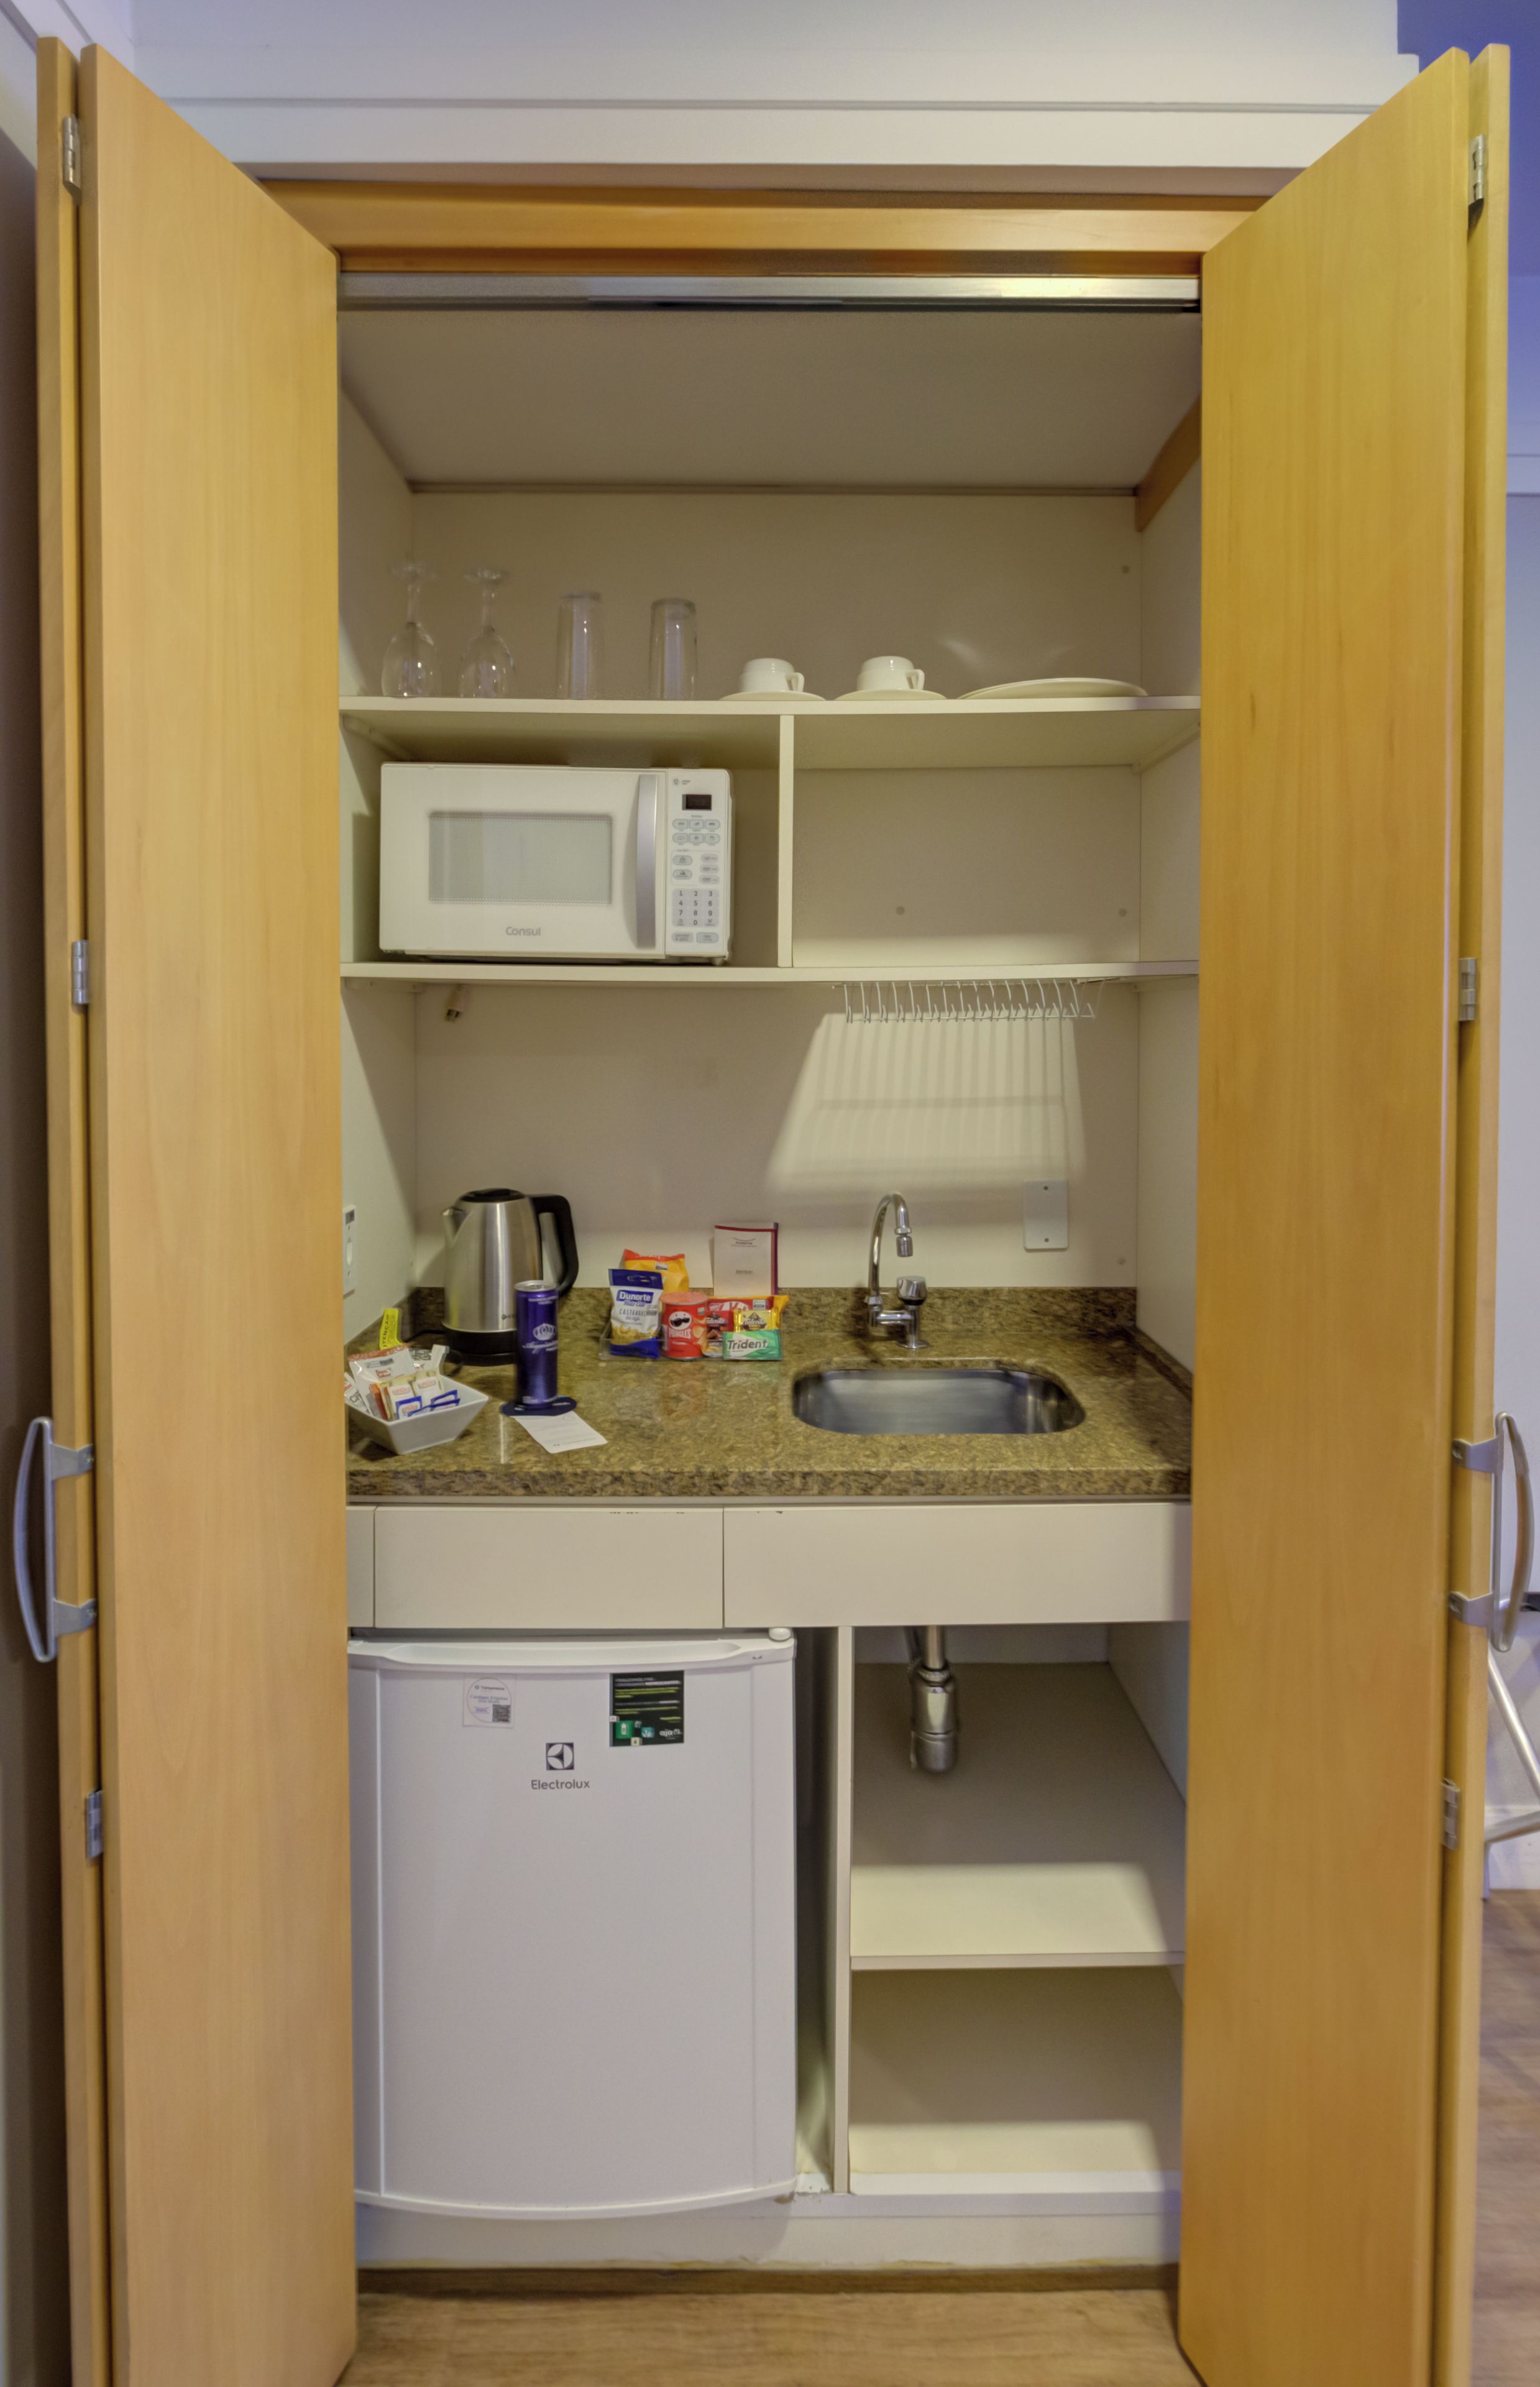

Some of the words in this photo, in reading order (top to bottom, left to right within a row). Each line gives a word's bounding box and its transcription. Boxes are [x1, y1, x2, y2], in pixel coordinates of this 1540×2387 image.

[506, 926, 541, 937] Consul
[619, 1291, 651, 1302] Dunorte
[726, 1339, 768, 1350] Trident
[531, 1778, 590, 1790] Electrolux
